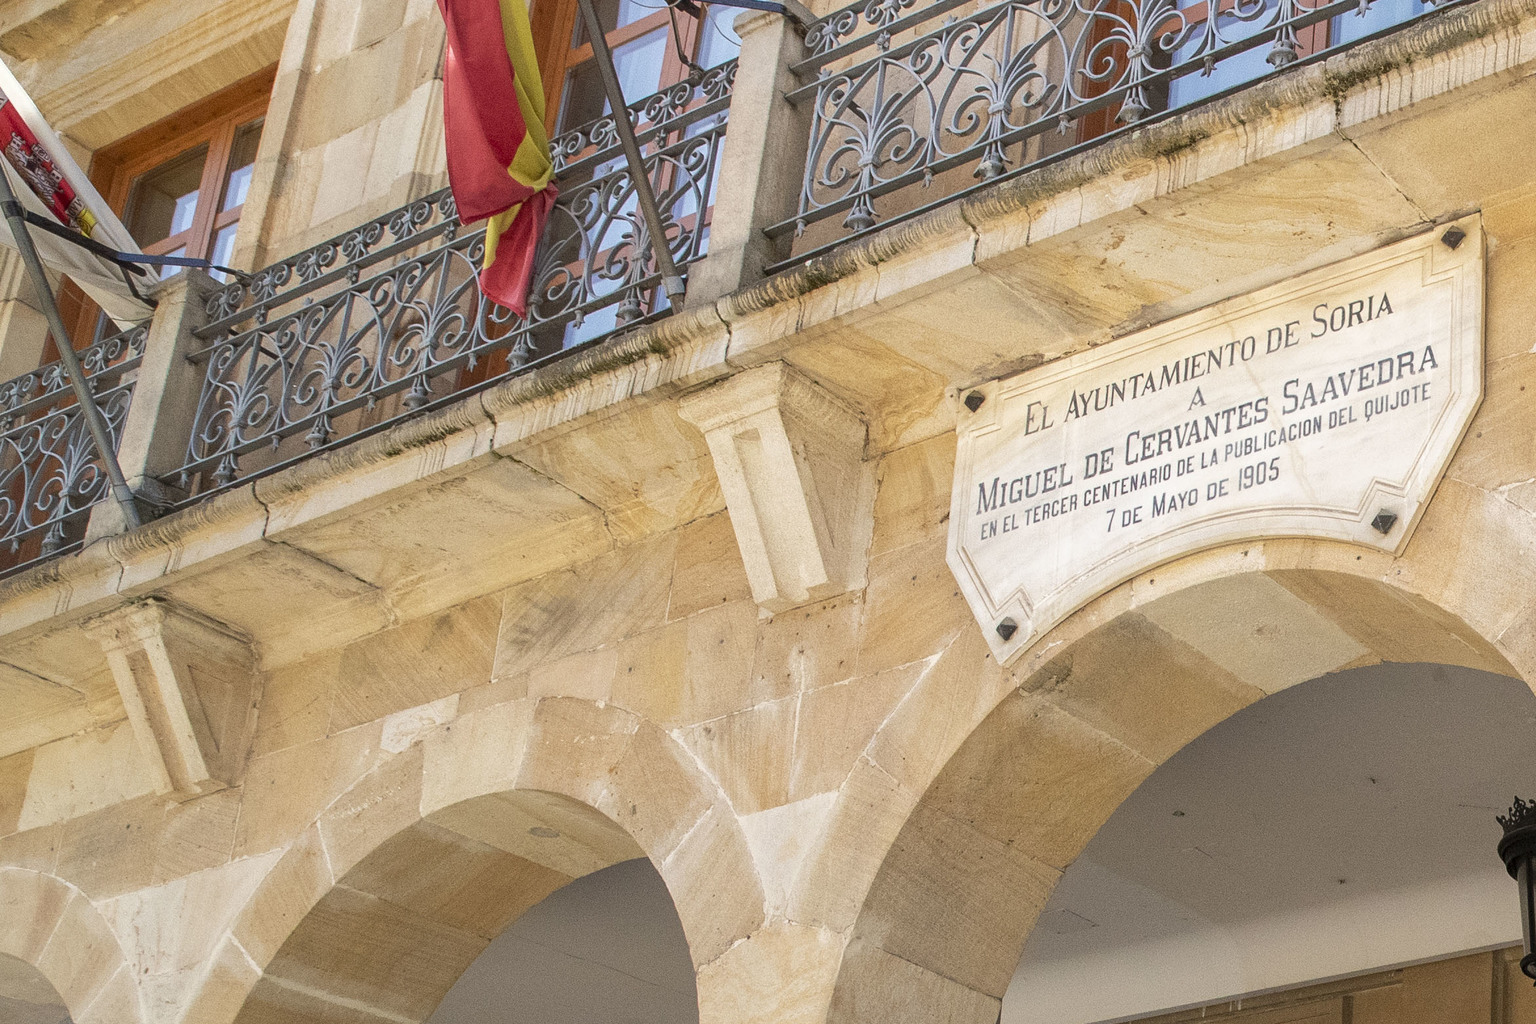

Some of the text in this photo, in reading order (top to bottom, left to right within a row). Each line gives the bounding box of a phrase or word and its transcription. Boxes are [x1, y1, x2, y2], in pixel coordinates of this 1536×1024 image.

[975, 345, 1439, 515] MIGUEL DE CERVANTES SAAVEDRA
[1024, 291, 1394, 436] EL AYUNTAMIENTO DE SORIA
[1187, 386, 1207, 411] A
[980, 382, 1432, 541] EN EL TERCER CENTENARIO DE LA PUBLICACION DEL QUIJOTE
[1105, 456, 1281, 533] 7 DE MAYO DE 1905
